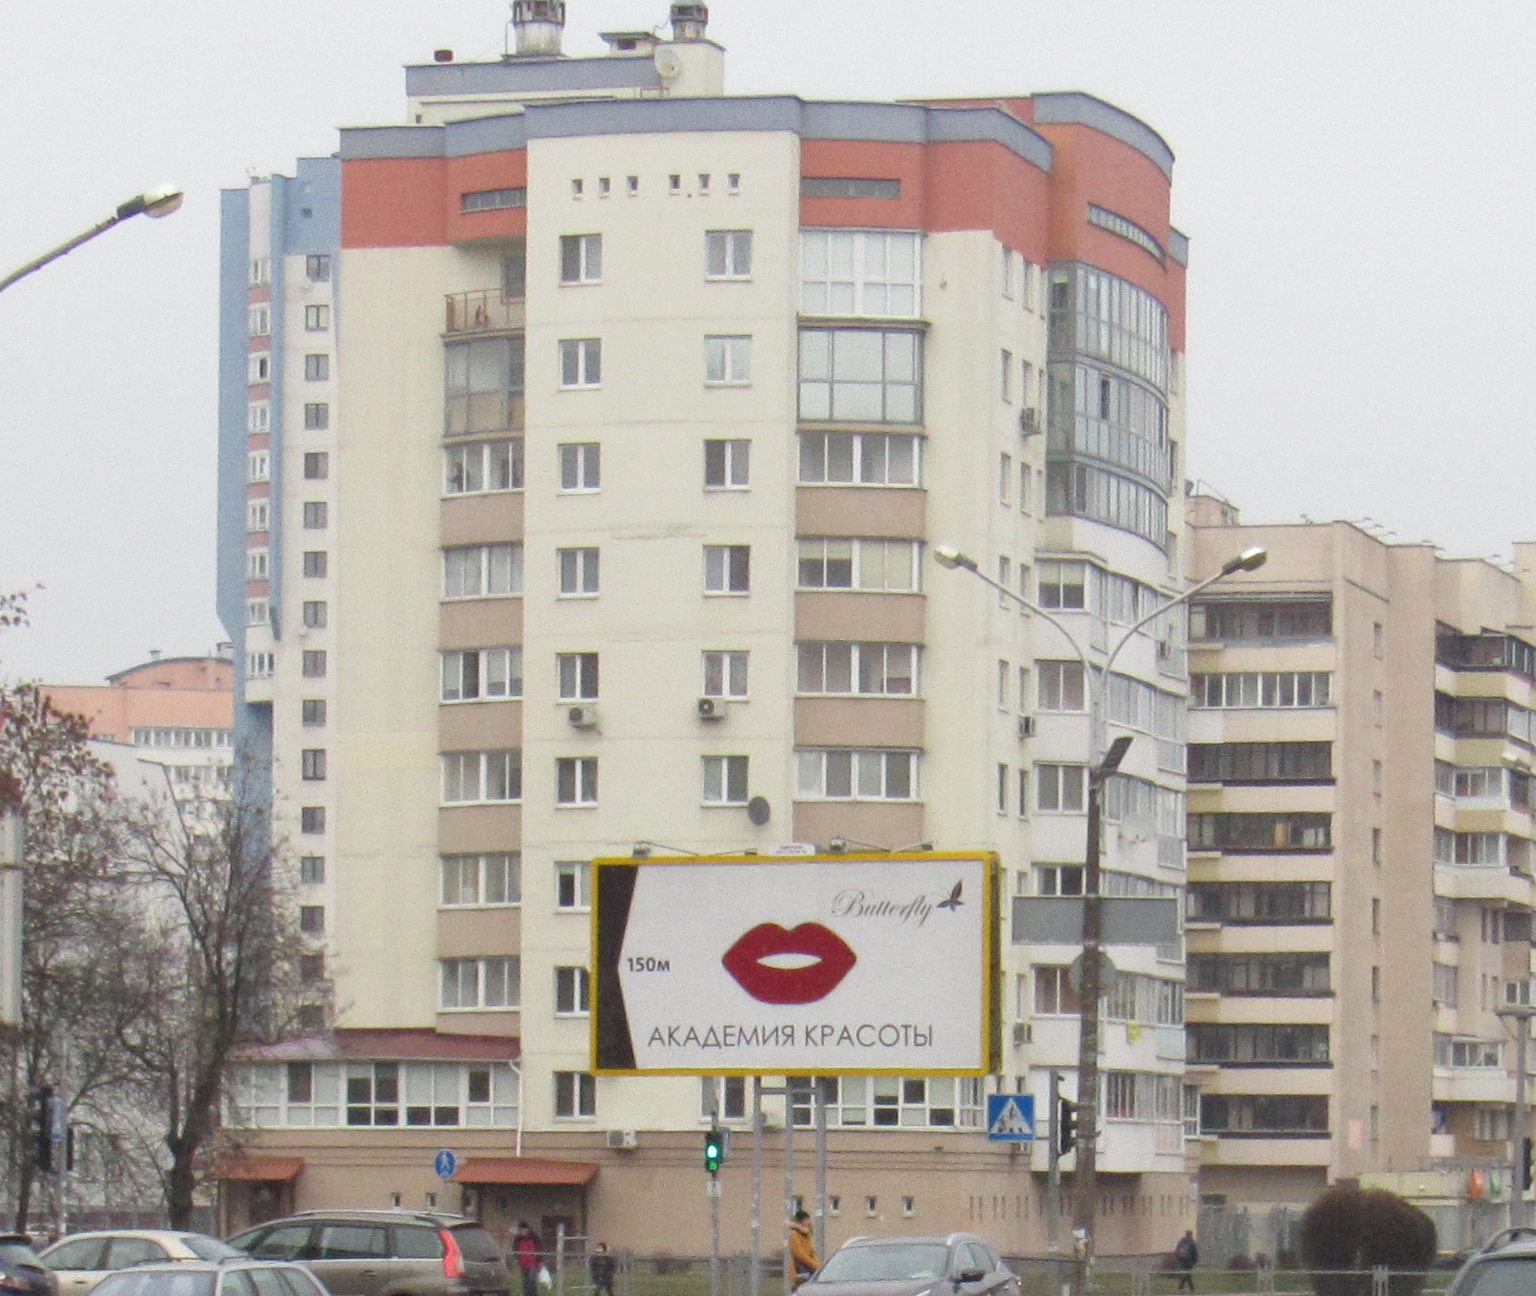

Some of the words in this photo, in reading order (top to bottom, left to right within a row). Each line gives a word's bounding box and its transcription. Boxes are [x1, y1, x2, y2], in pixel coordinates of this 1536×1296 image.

[831, 888, 933, 927] Butterfly
[627, 957, 671, 973] 150м
[647, 1024, 796, 1050] АКАДЕМИЯ
[804, 1023, 934, 1049] КРАСОТЫ
